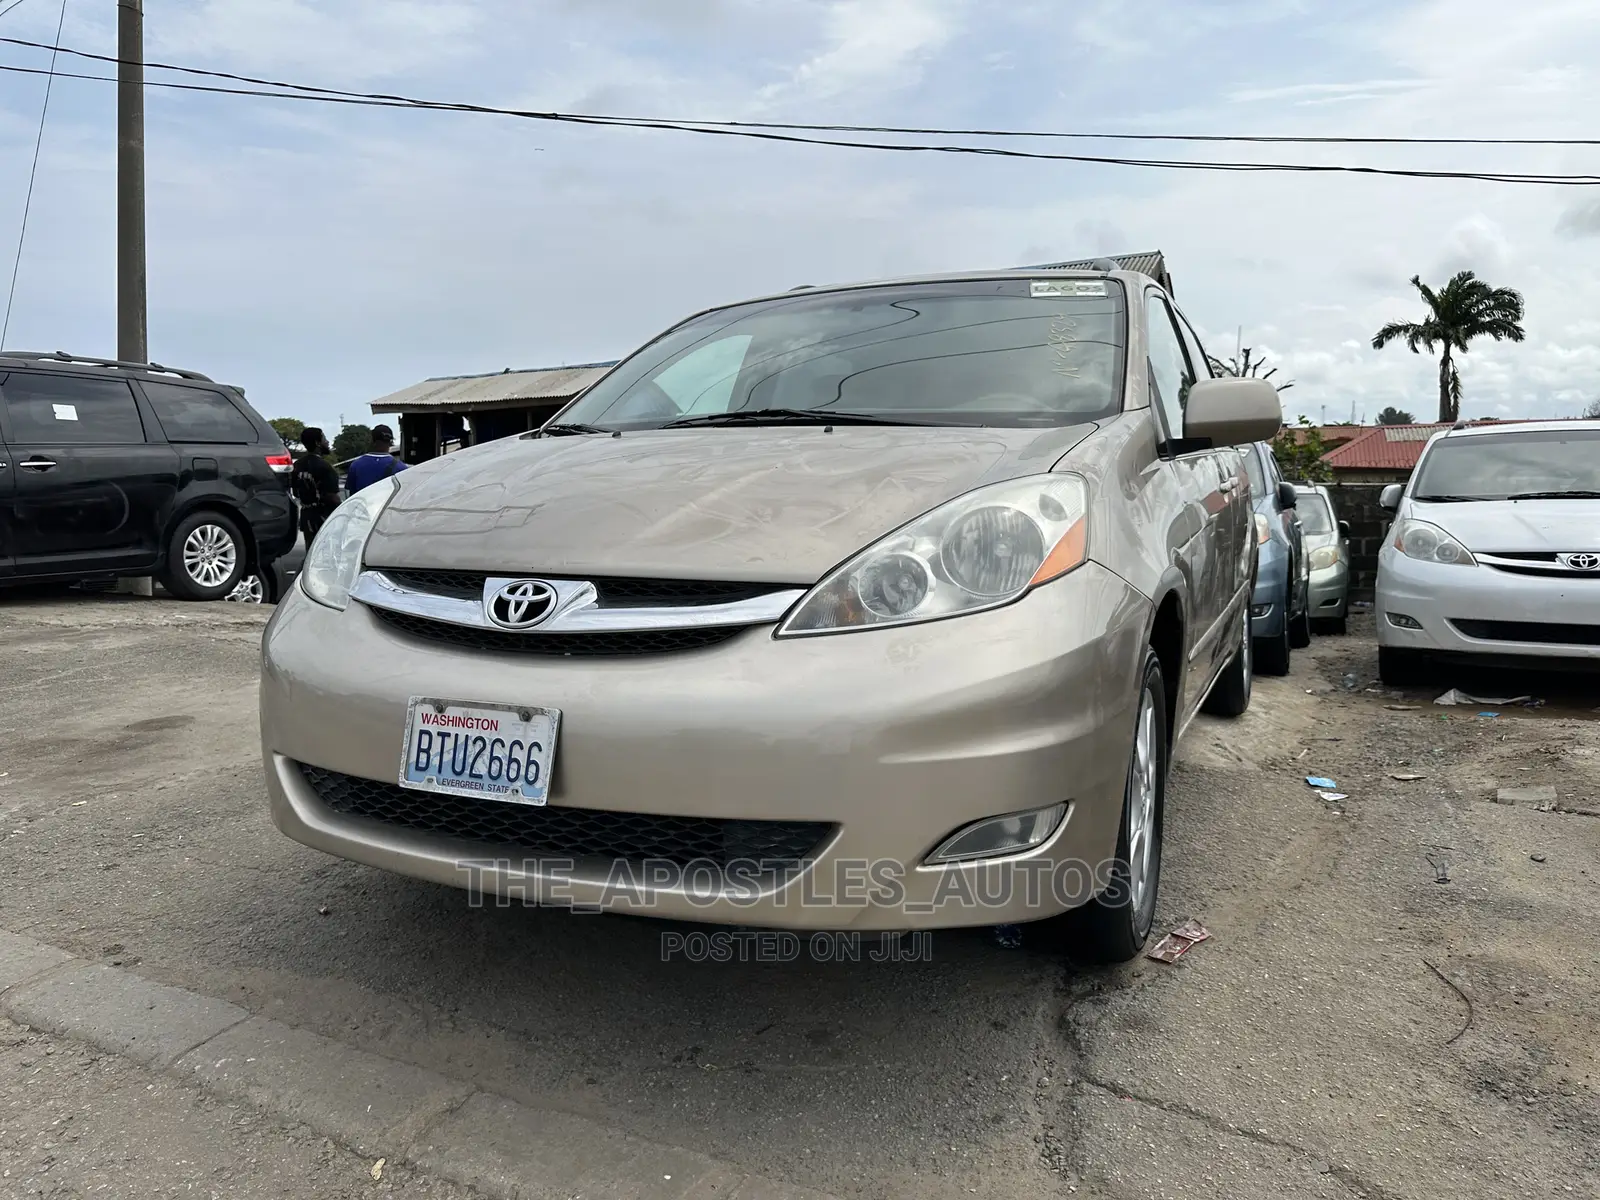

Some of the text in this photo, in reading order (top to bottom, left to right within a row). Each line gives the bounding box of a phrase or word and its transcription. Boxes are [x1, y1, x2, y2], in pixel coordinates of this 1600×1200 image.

[421, 713, 499, 731] WASHINGTON
[415, 729, 543, 785] BTU2666
[442, 779, 509, 794] EVERGREEN STATE
